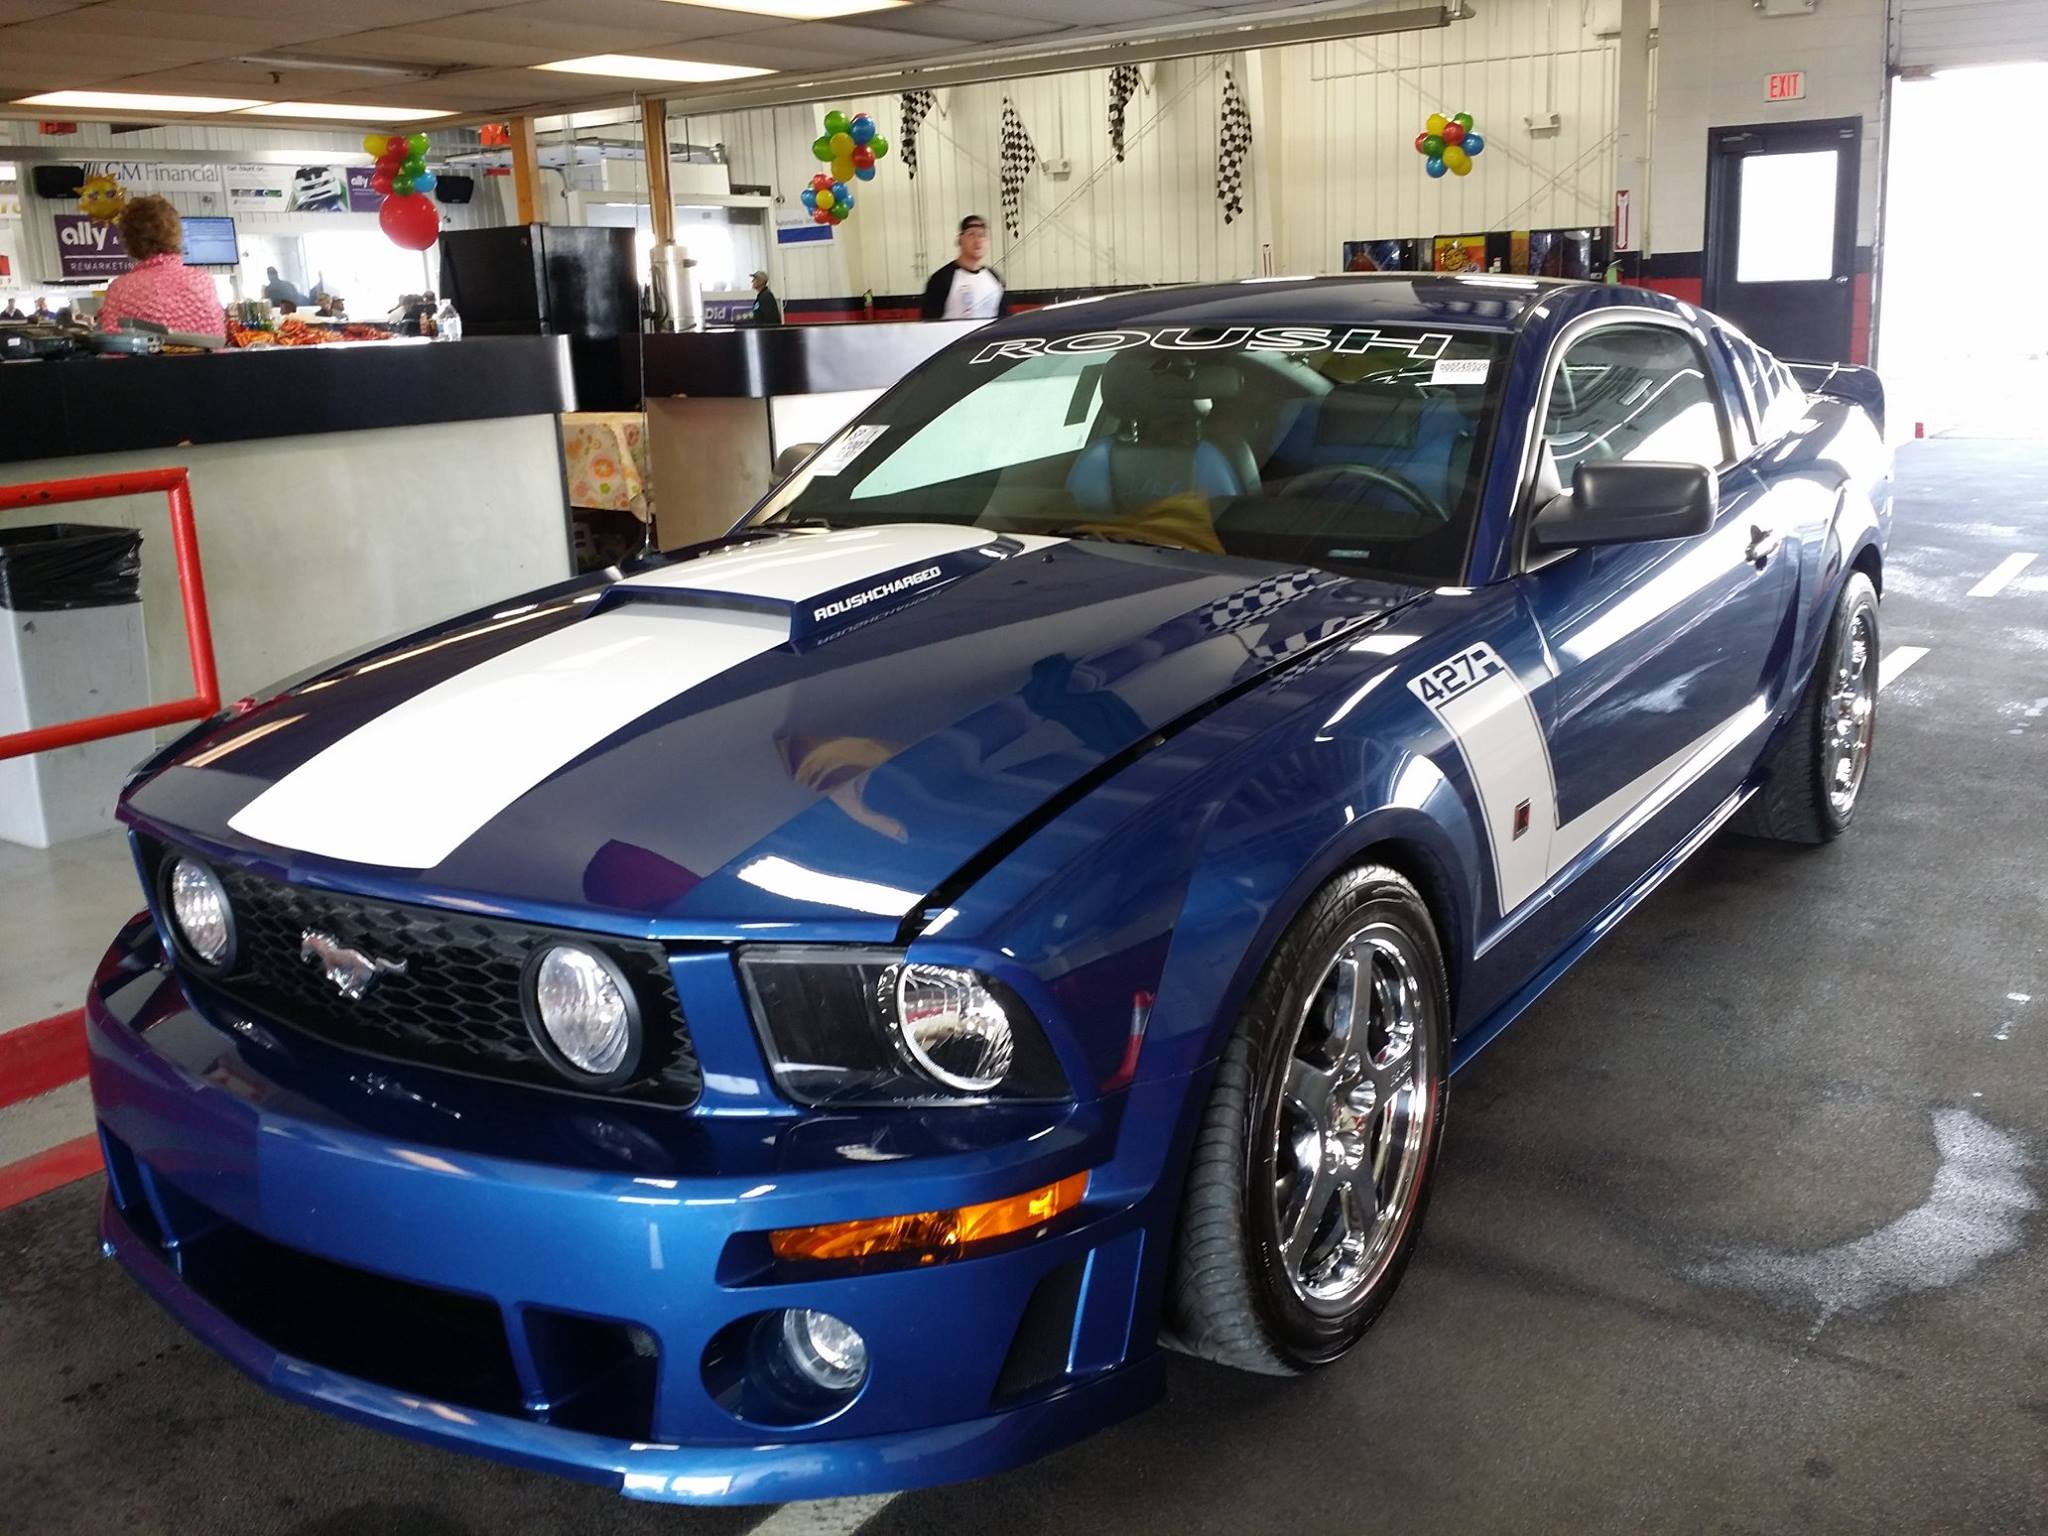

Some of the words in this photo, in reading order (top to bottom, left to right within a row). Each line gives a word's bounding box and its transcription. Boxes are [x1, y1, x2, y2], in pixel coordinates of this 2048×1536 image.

[1769, 73, 1799, 99] EXIT
[105, 162, 141, 181] GM
[145, 162, 219, 182] Financial
[61, 221, 107, 251] ally
[70, 262, 136, 271] REMARKETIN
[969, 327, 1453, 364] ROUSH
[813, 566, 942, 622] ROUSHCHARGED
